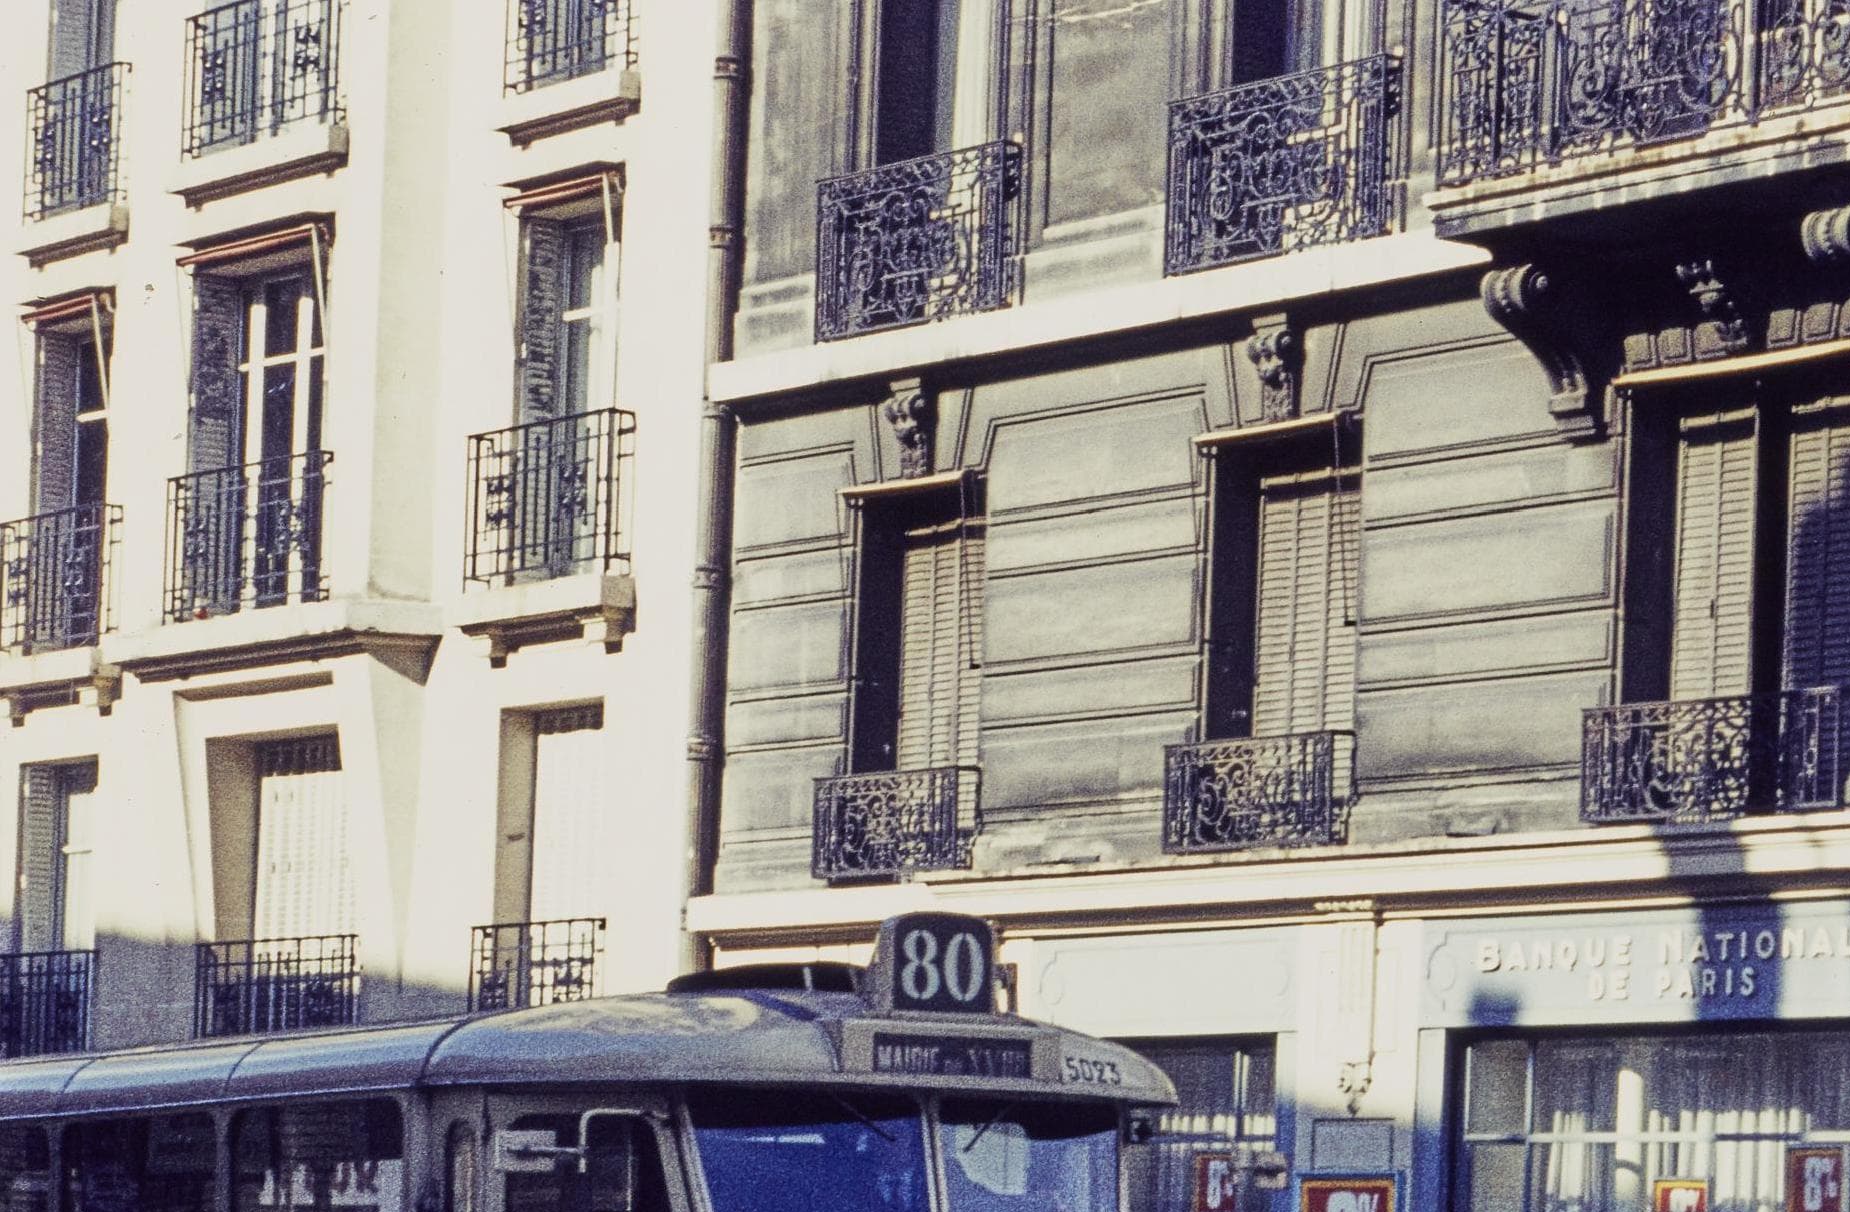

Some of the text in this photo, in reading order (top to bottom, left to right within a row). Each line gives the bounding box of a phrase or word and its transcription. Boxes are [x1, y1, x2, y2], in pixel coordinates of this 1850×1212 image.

[900, 928, 985, 1003] 80
[1477, 936, 1634, 973] BANQUE
[1589, 967, 1757, 1001] DE PARIS
[1065, 1056, 1122, 1086] 5023
